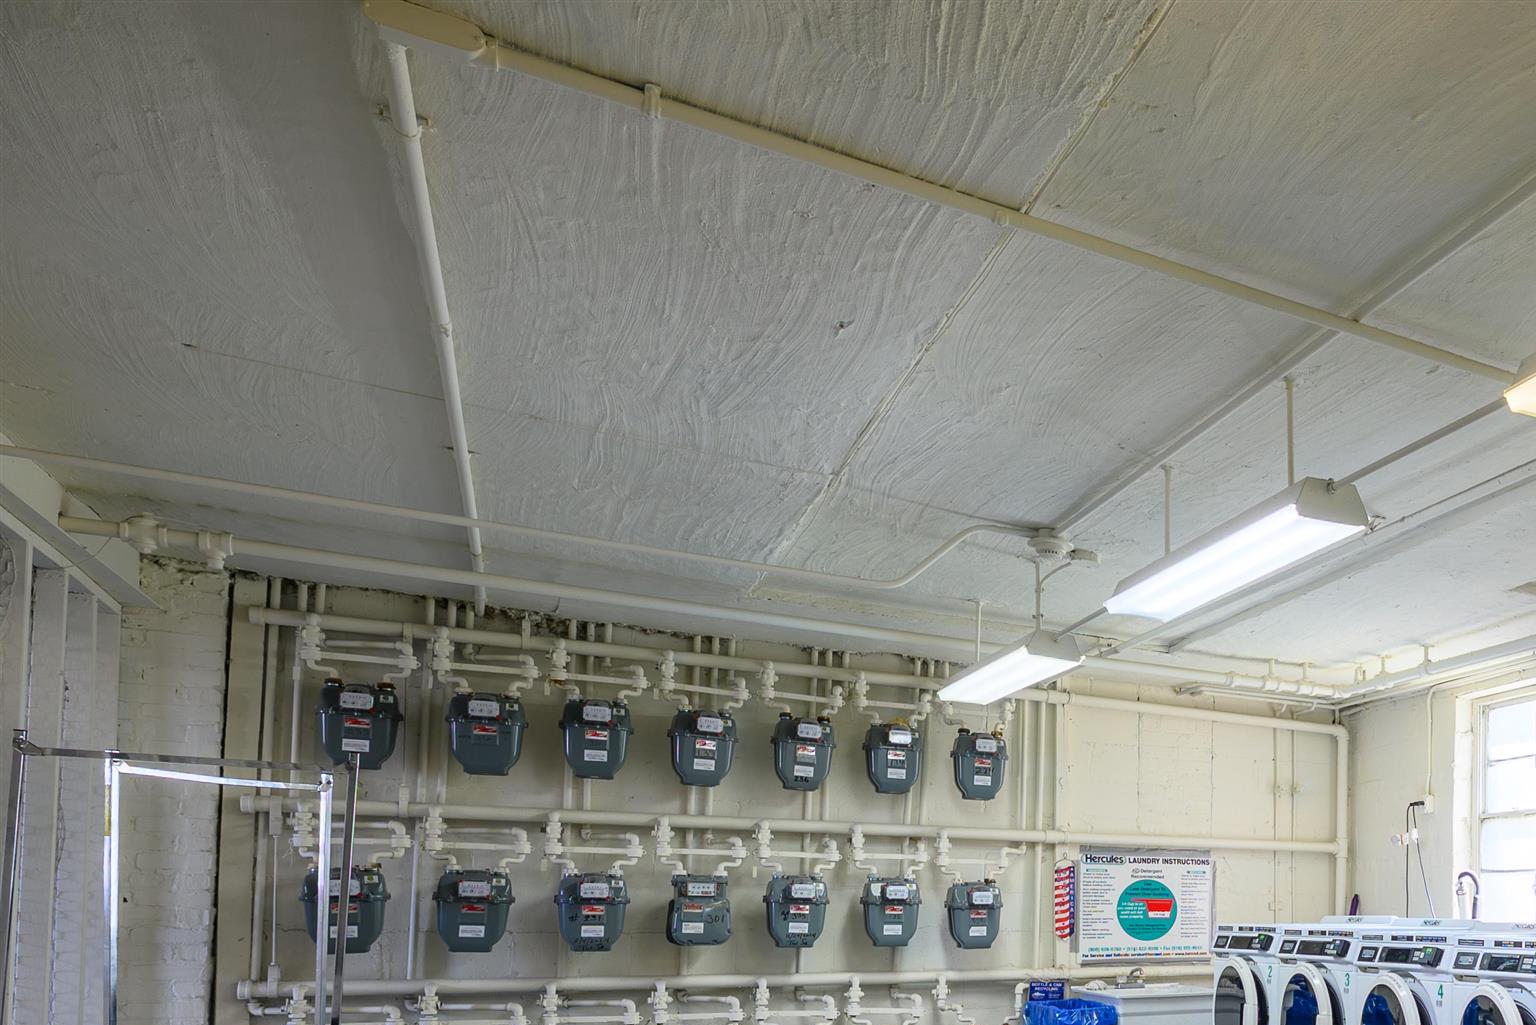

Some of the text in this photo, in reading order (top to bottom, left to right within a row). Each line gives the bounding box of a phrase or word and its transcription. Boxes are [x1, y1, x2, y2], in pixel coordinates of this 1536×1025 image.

[1085, 853, 1124, 864] Hercules
[1162, 857, 1210, 866] INSTRUCTIONS
[704, 914, 725, 924] 301
[1268, 965, 1273, 978] 2
[1344, 973, 1350, 987] 3
[1437, 984, 1444, 999] 4
